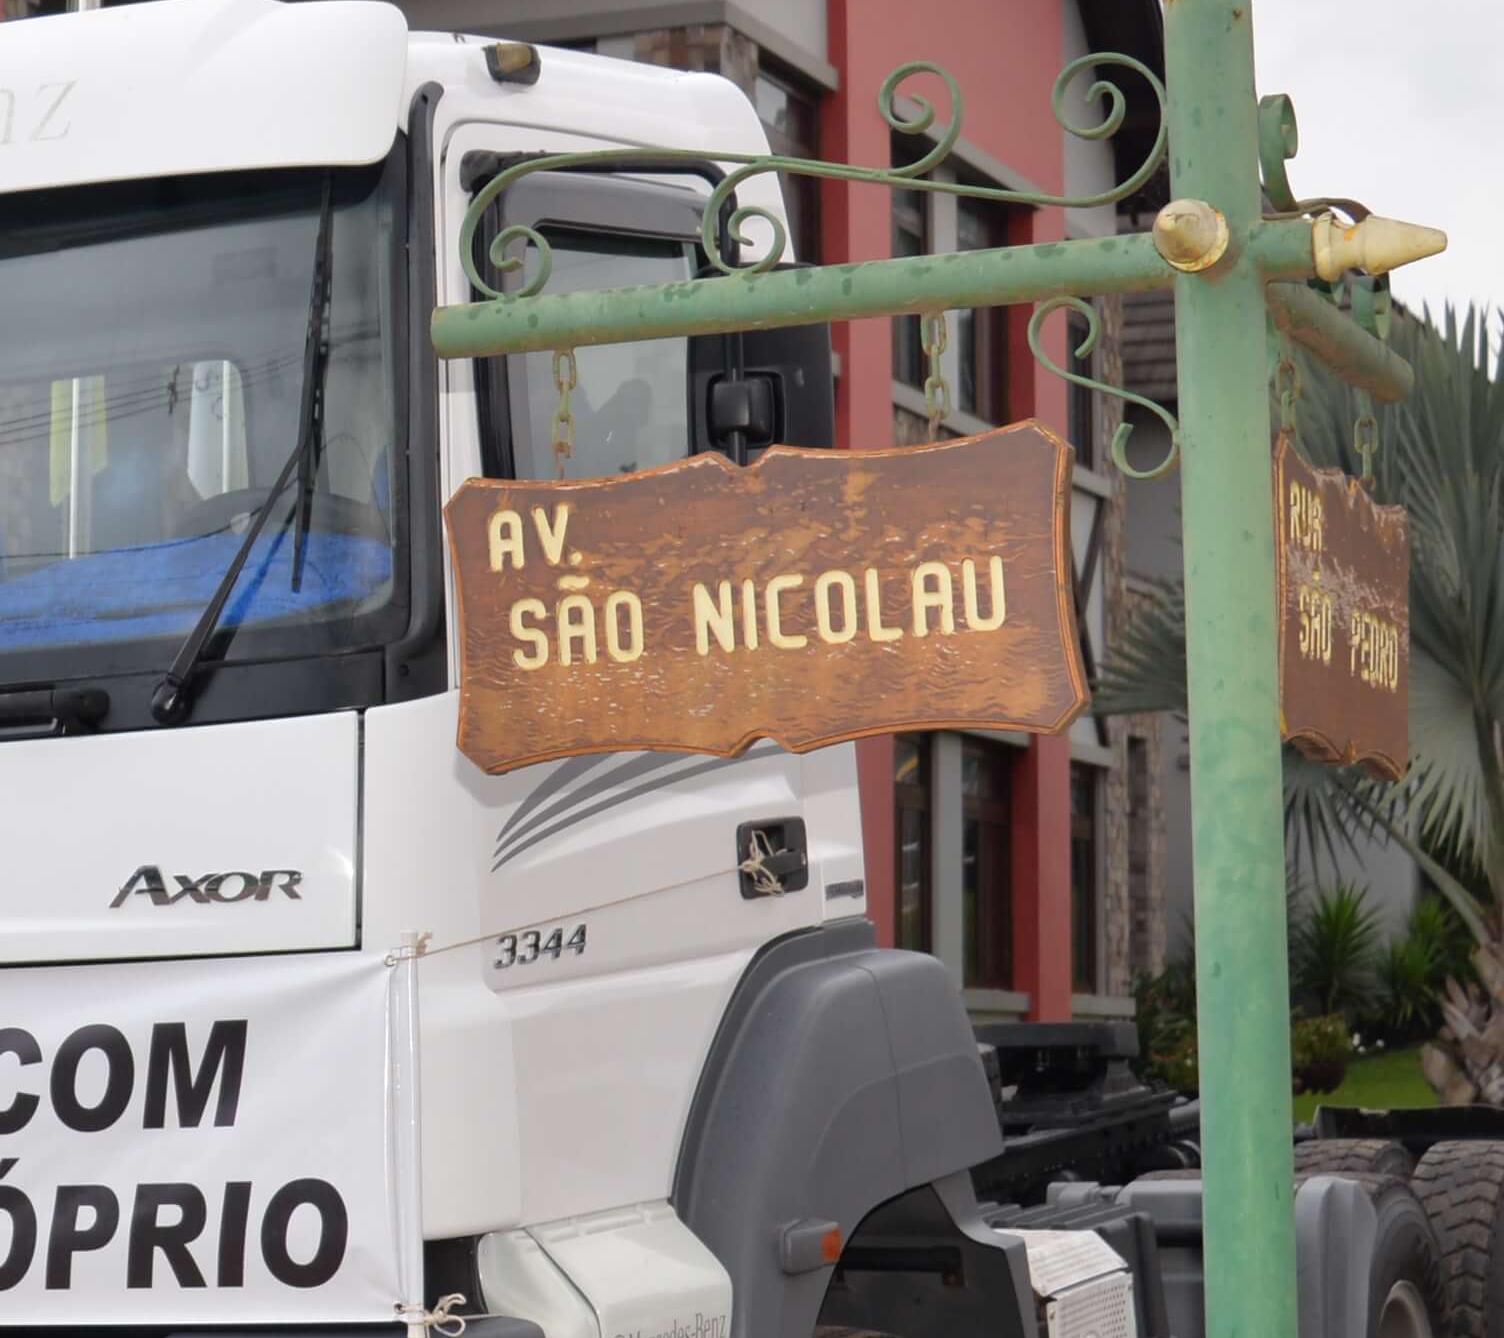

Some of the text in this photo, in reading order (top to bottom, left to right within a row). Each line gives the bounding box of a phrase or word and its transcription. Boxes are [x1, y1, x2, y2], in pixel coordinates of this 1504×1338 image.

[488, 503, 583, 572] AV.
[1290, 480, 1322, 552] RUA
[509, 555, 1006, 671] SÃO NICOLAU
[1299, 569, 1399, 693] SÃO PEDRO
[493, 924, 587, 970] 3344
